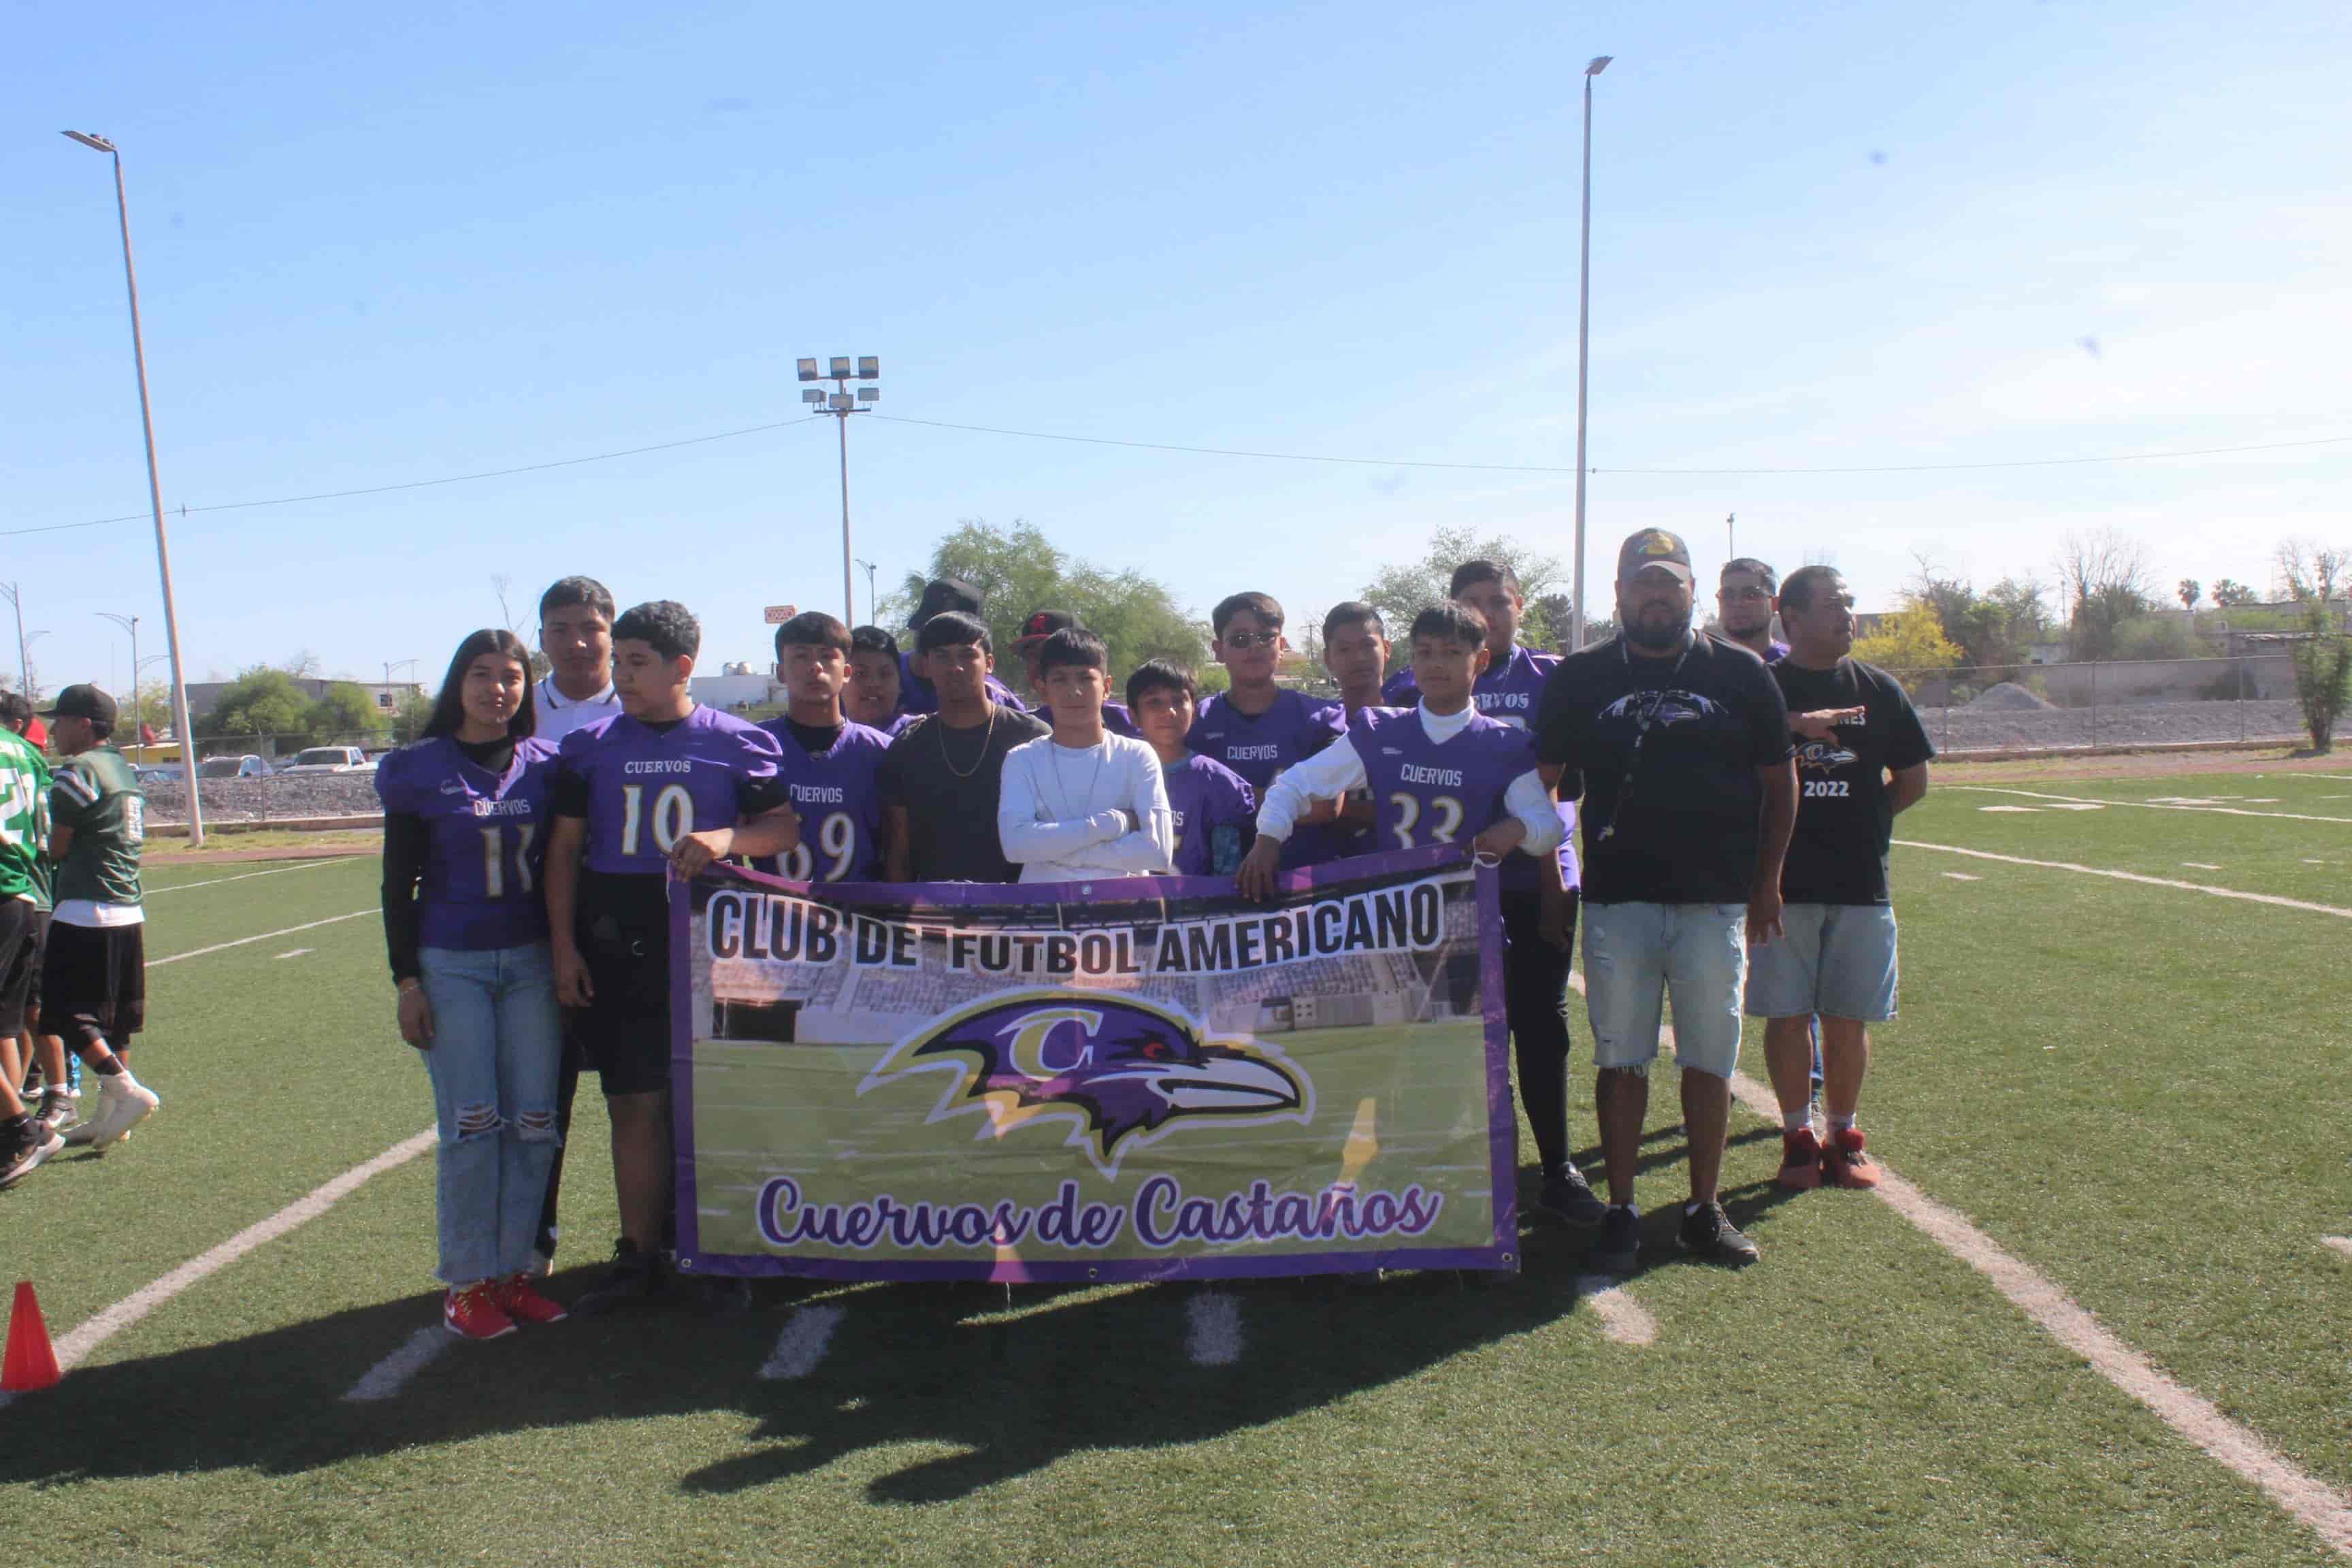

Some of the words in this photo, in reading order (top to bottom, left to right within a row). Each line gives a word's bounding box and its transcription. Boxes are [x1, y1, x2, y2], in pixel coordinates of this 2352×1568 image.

[1227, 745, 1277, 760] CUERVOS
[625, 761, 691, 773] CUERVOS
[1401, 764, 1463, 787] CUERVOS
[789, 784, 843, 803] CUERVOS
[1804, 781, 1850, 797] 2022
[474, 799, 532, 817] CUERVOS
[622, 784, 695, 855] 10
[710, 892, 840, 964] CLUB
[853, 917, 919, 967] DE
[949, 932, 1141, 975] FUTBOL
[1156, 884, 1442, 974] AMERICANO
[758, 1177, 1032, 1247] Cuervos
[1036, 1181, 1123, 1247] de
[1134, 1175, 1439, 1247] Castaños
